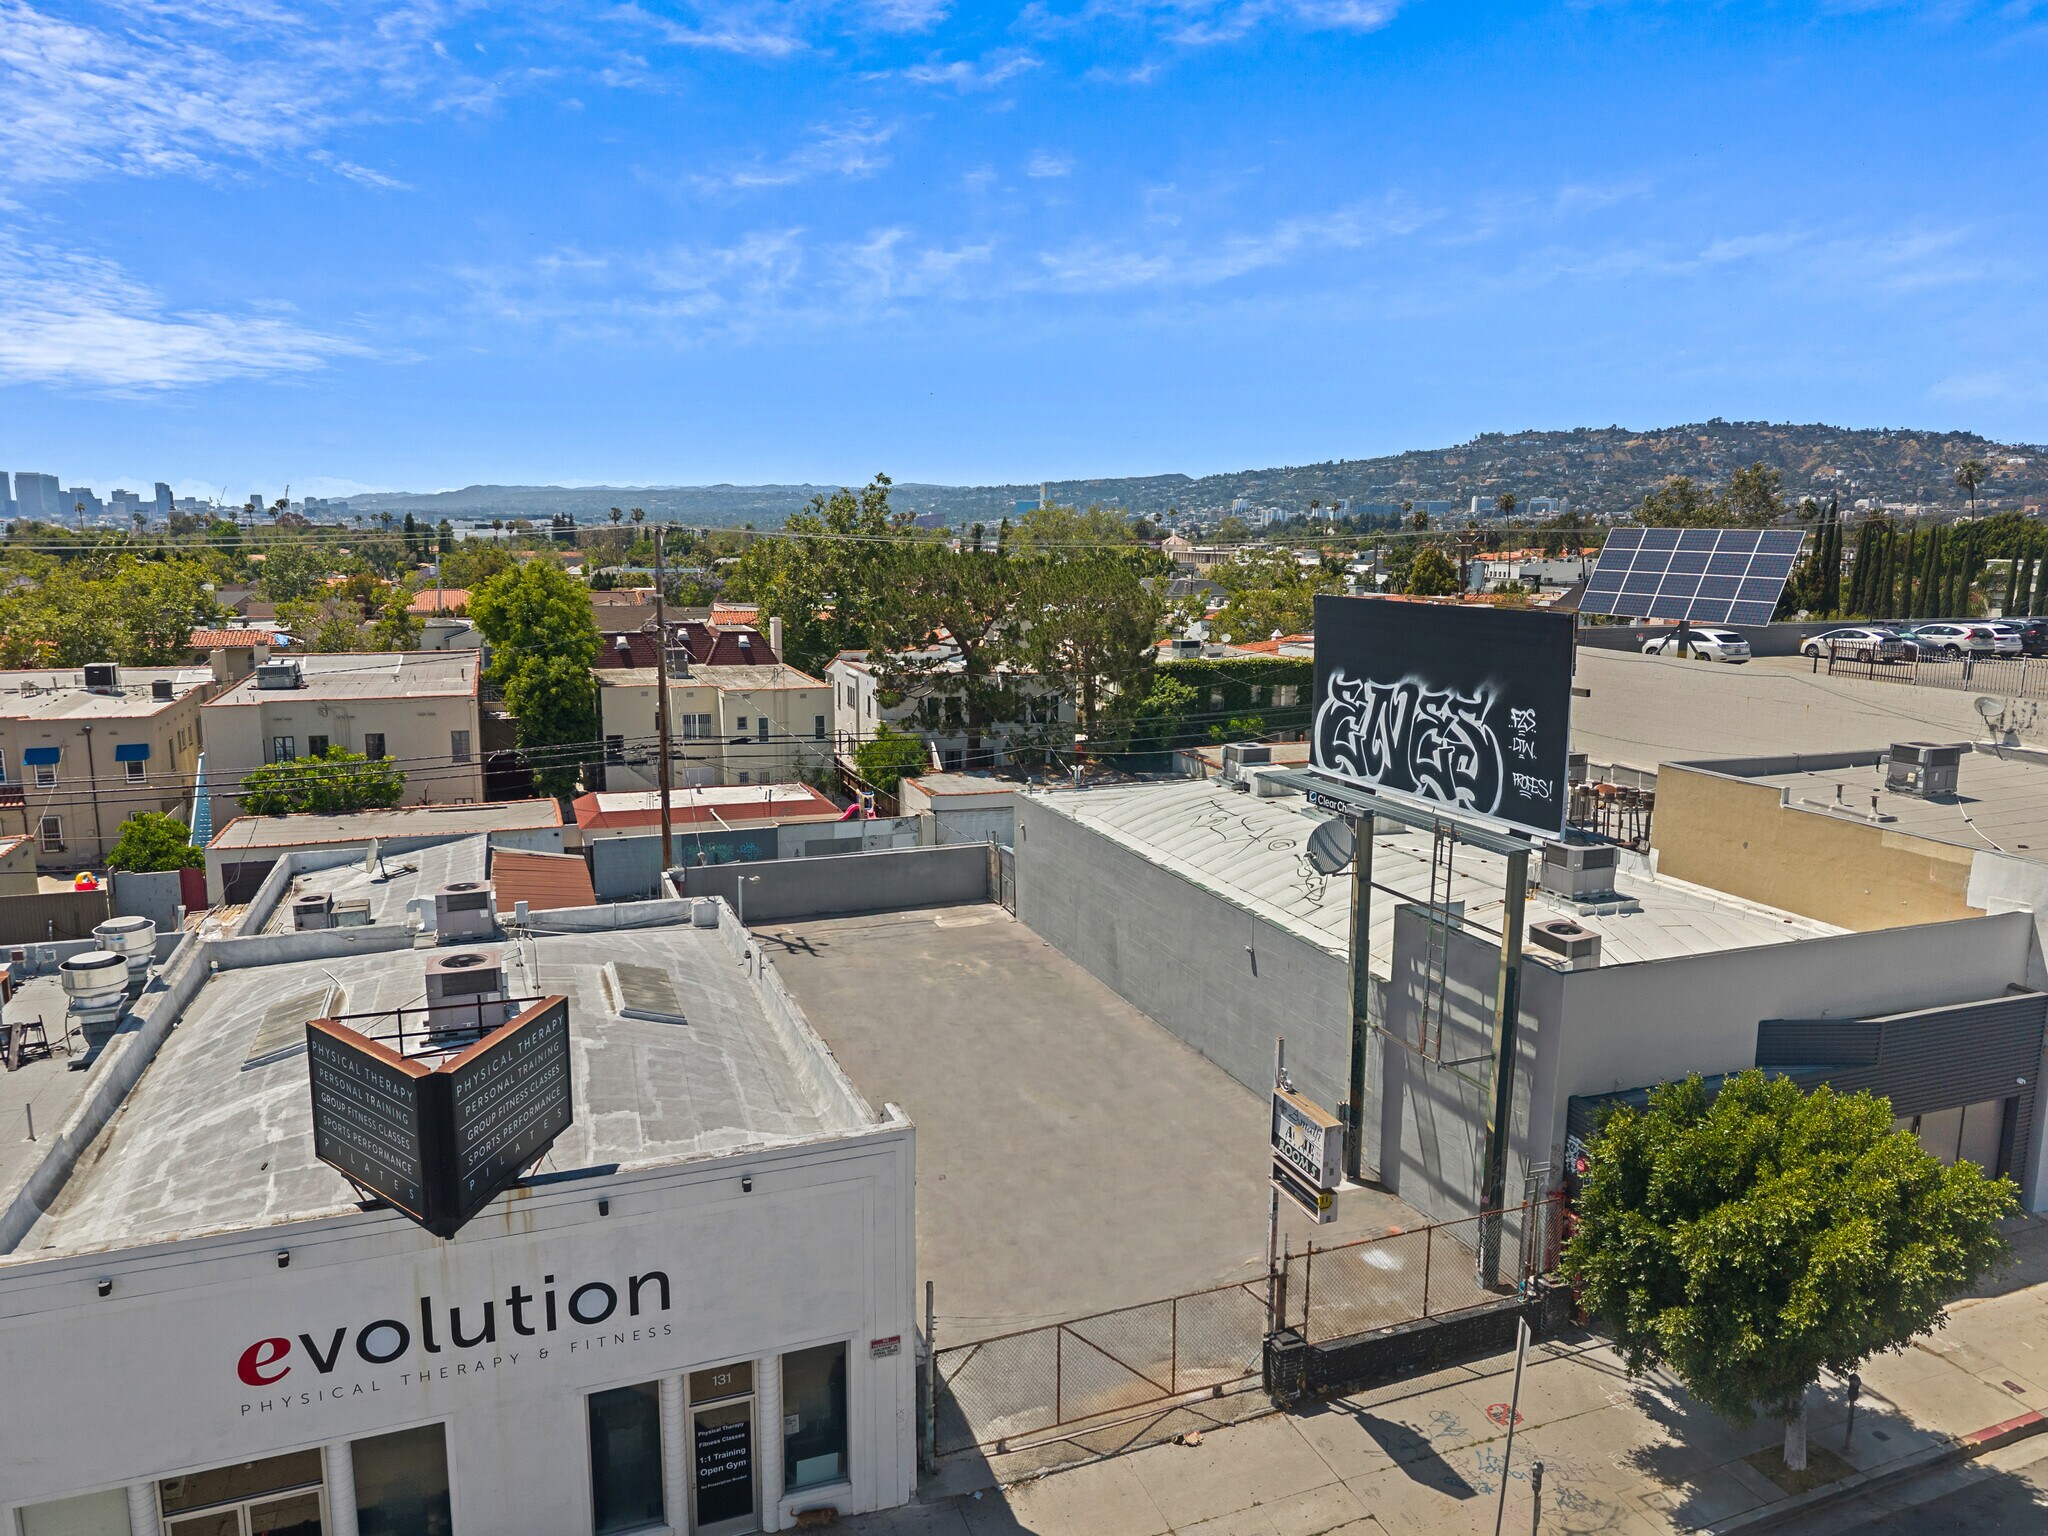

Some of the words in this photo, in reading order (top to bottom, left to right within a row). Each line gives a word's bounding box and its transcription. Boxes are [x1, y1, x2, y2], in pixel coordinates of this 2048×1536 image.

[1317, 795, 1337, 810] Clear
[312, 1040, 361, 1075] PHYSICAL
[365, 1068, 413, 1103] THERAPY
[456, 1050, 514, 1097] PHYSICAL
[517, 1014, 564, 1053] THERAPY
[465, 1075, 515, 1117] PERSONAL
[518, 1041, 559, 1078] TRAINING
[319, 1068, 363, 1099] PERSONAL
[365, 1092, 408, 1125] TRAINING
[321, 1092, 346, 1113] GROUP
[347, 1107, 377, 1130] FITNESS
[378, 1123, 410, 1150] CLASSES
[467, 1112, 496, 1141] GROUP
[498, 1090, 529, 1118] FITNESS
[530, 1064, 560, 1095] CLASSES
[468, 1135, 501, 1166] SPORTS
[503, 1086, 561, 1138] PERFORMANCE
[323, 1115, 351, 1138] SPORTS
[353, 1132, 412, 1175] PERFORMANCE
[324, 1138, 414, 1200] PILATES
[469, 1108, 562, 1191] PILATES
[1279, 1138, 1309, 1172] ROOM
[237, 1271, 671, 1386] evolution
[241, 1381, 380, 1416] PHYSICAL
[401, 1352, 520, 1386] THERAPY
[538, 1347, 549, 1360] &
[570, 1323, 673, 1353] FITNESS
[712, 1373, 731, 1387] 131
[698, 1427, 721, 1437] Physical
[722, 1422, 744, 1431] Therapy
[699, 1439, 720, 1448] Fitness
[722, 1433, 745, 1442] Classes
[699, 1455, 712, 1464] 1:1
[713, 1447, 746, 1461] Training
[700, 1465, 724, 1476] Open
[726, 1459, 747, 1470] Gym
